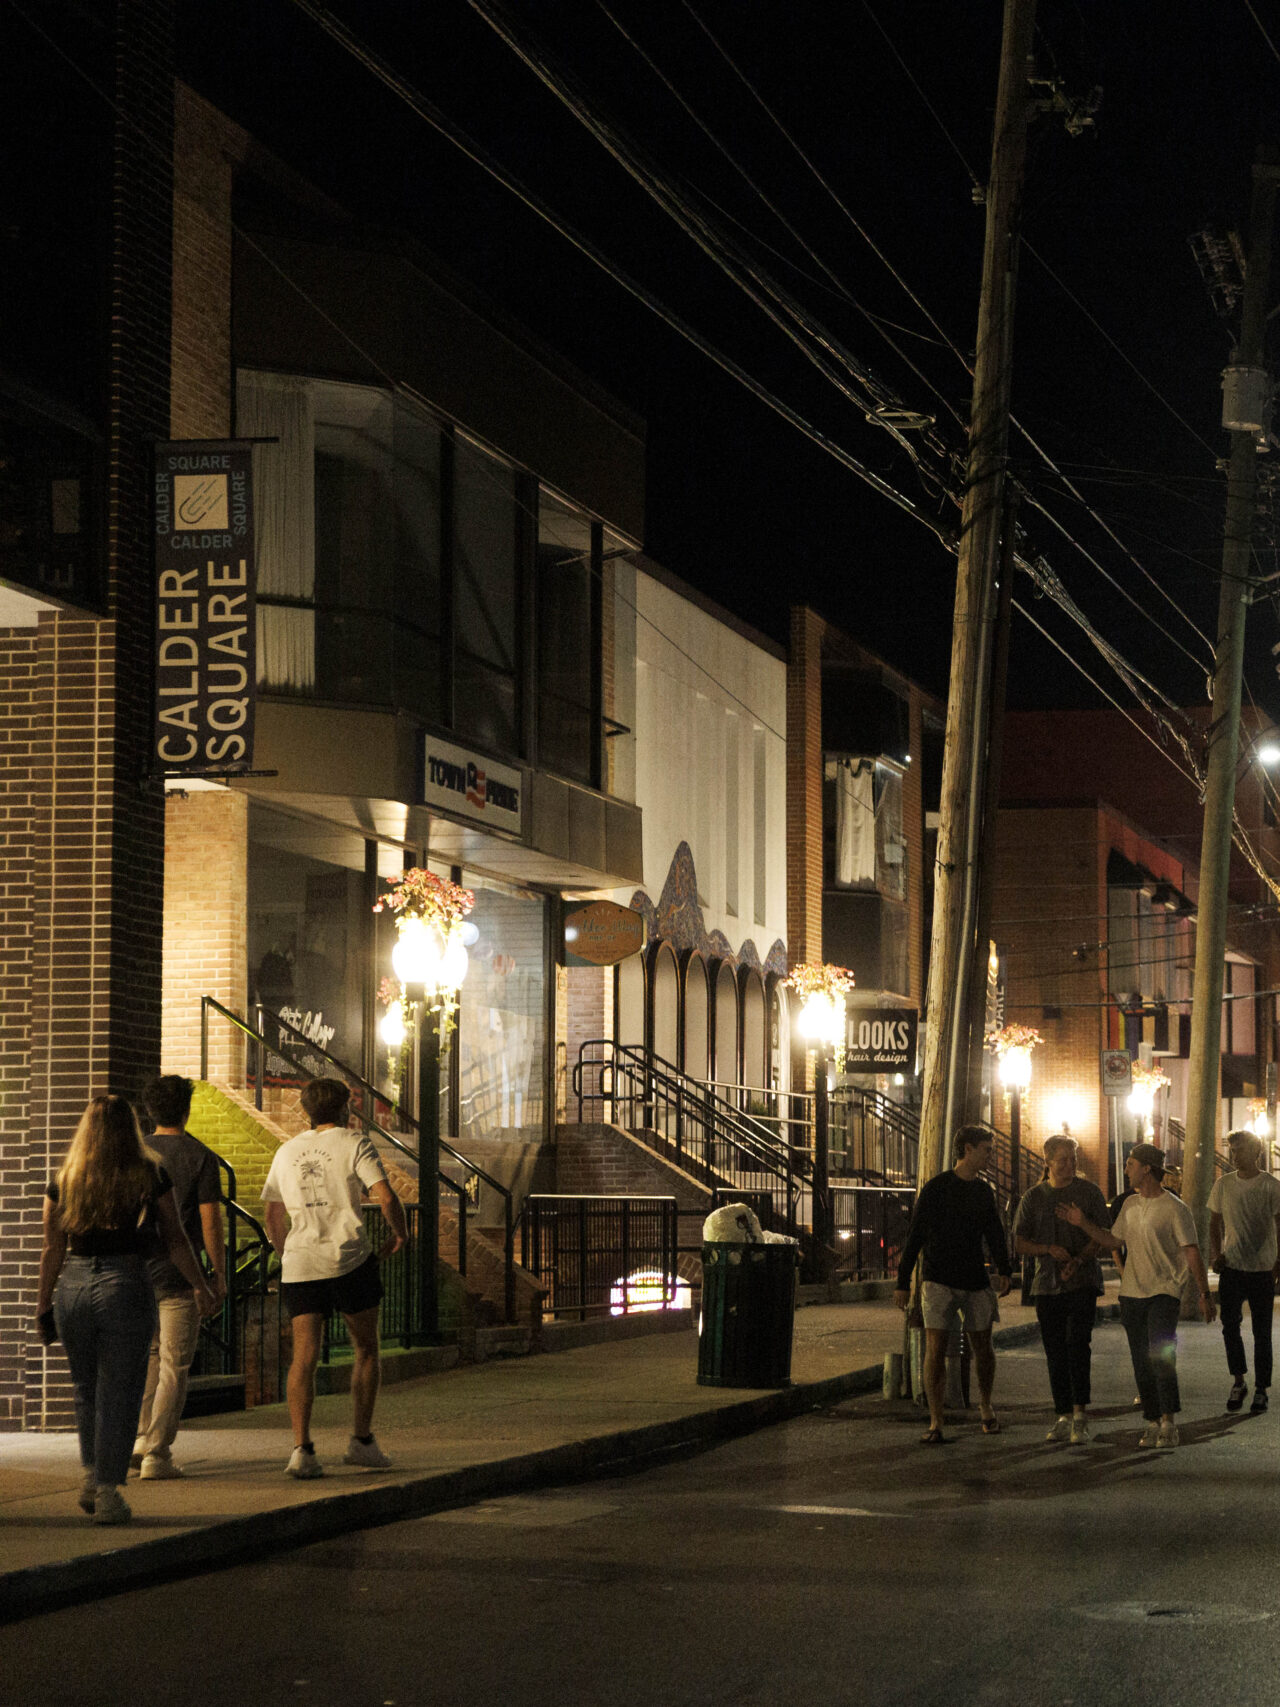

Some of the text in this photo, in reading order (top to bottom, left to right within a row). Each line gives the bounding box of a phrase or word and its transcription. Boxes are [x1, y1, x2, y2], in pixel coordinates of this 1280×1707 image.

[167, 455, 231, 470] SQUARE
[155, 472, 169, 535] CALDER
[233, 470, 247, 536] SQUARE
[170, 534, 233, 550] CALDER
[157, 568, 199, 763] CALDER
[205, 559, 249, 761] SQUARE
[847, 1051, 909, 1065] hair design
[848, 1020, 909, 1050] LOOKS
